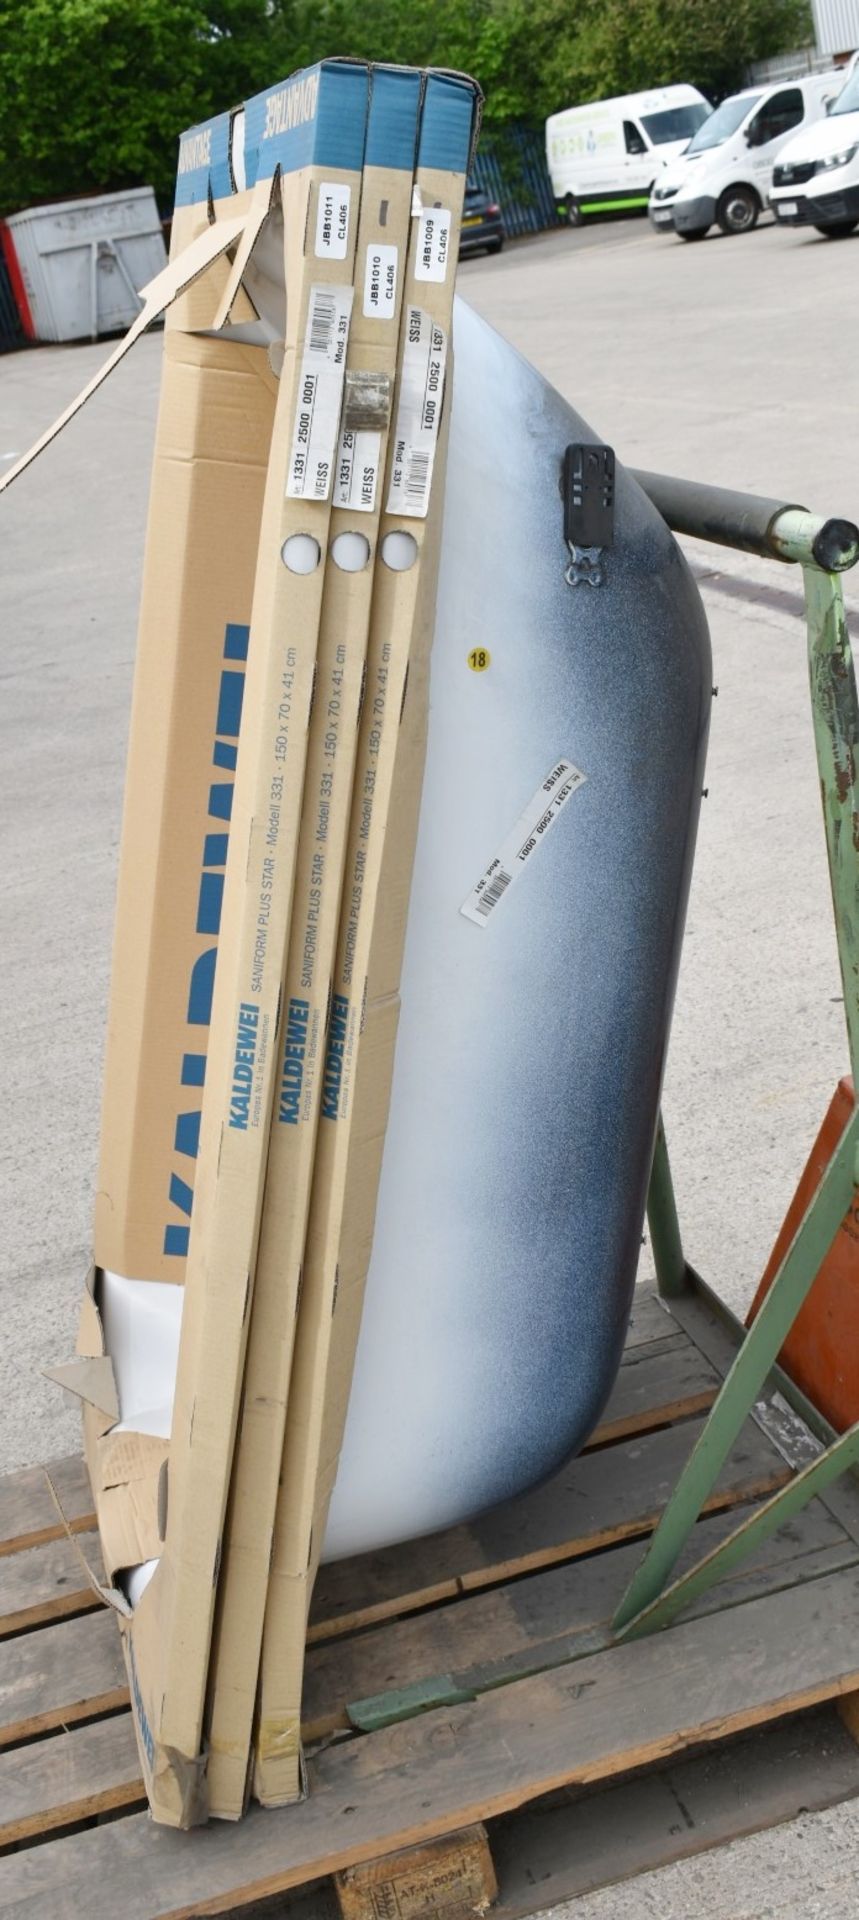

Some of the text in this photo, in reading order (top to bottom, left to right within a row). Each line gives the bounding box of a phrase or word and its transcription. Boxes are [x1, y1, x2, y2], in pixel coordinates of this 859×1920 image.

[263, 73, 320, 139] ADVANTAGE
[322, 196, 333, 247] JBB1011
[338, 204, 348, 240] CL406
[422, 219, 434, 269] JBB1009
[438, 228, 448, 263] CL406
[370, 256, 381, 306] JBB1010
[385, 264, 395, 300] CL406
[338, 315, 348, 334] 331
[409, 310, 421, 343] WEISS
[303, 374, 315, 404] 0001
[428, 361, 440, 392] 2500
[297, 413, 310, 443] 2500
[424, 400, 436, 430] 0001
[294, 453, 305, 480] 1331
[314, 462, 329, 498] WEISS
[340, 458, 350, 486] 1331
[393, 469, 402, 487] 331
[361, 467, 374, 505] WEISS
[286, 647, 297, 667] cm
[336, 644, 346, 664] cm
[382, 643, 392, 662] cm
[470, 651, 486, 668] 18
[282, 671, 295, 689] 41
[332, 669, 344, 686] 41
[377, 667, 388, 684] 41
[279, 703, 291, 721] 70
[328, 700, 340, 717] 70
[373, 698, 385, 715] 70
[275, 736, 288, 762] 150
[325, 732, 337, 759] 150
[369, 730, 381, 755] 150
[271, 775, 284, 800] 331
[320, 771, 333, 797] 331
[365, 769, 376, 794] 331
[542, 764, 568, 791] WEISS
[266, 804, 280, 846] Modell
[316, 800, 330, 843] Modell
[360, 798, 373, 840] Modell
[519, 785, 572, 861] 1331 2500 0001
[262, 857, 276, 889] STAR
[312, 853, 325, 886] STAR
[354, 850, 367, 883] STAR
[474, 879, 487, 894] 331
[258, 893, 272, 926] PLUS
[308, 889, 321, 922] PLUS
[350, 886, 362, 919] PLUS
[251, 928, 267, 993] SANIFORM
[301, 924, 317, 988] SANIFORM
[343, 921, 357, 985] SANIFORM
[228, 1002, 260, 1130] KALDEWEI
[278, 998, 310, 1125] KALDEWEI
[322, 993, 350, 1121] KALDEWEI
